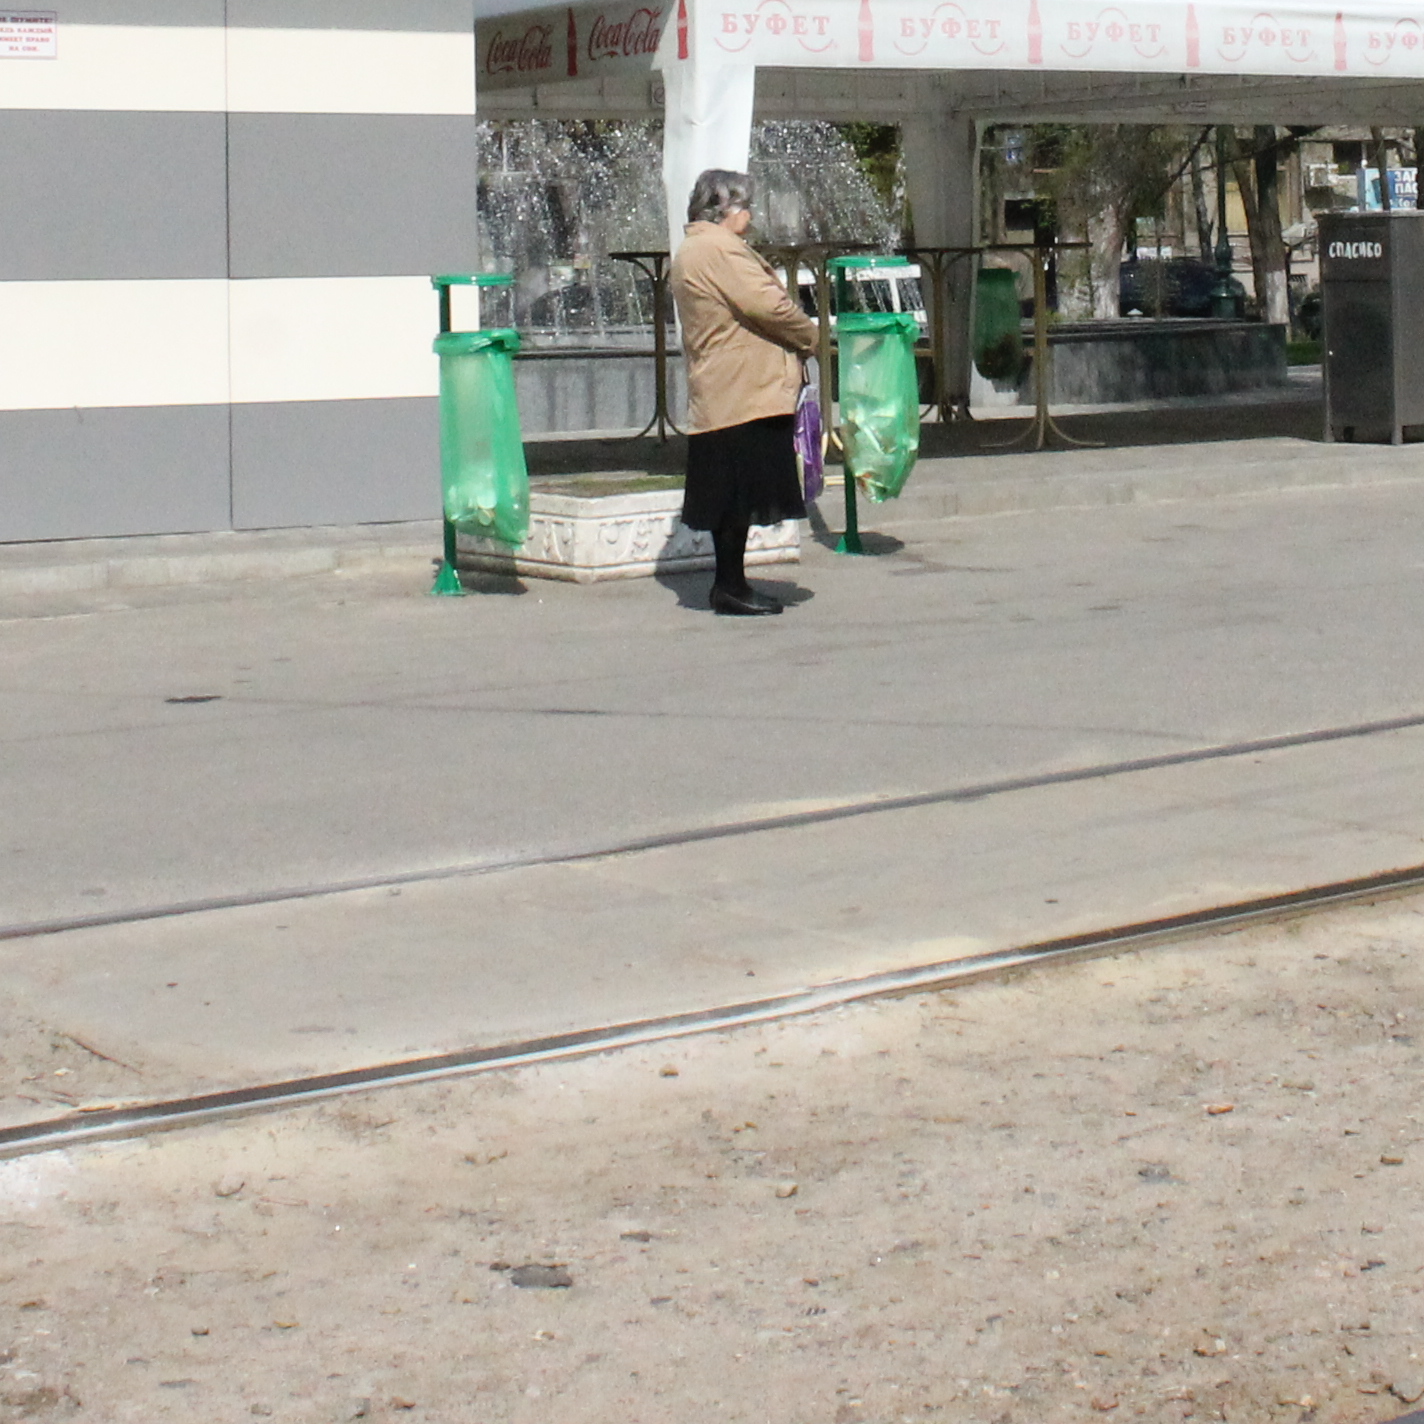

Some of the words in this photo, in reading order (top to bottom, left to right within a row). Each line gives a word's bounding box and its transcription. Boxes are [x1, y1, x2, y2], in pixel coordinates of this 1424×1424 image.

[721, 13, 830, 37] БУФЕТ
[900, 17, 1002, 40] БУФЕТ
[1067, 22, 1161, 43] БУФЕТ
[1222, 27, 1312, 48] БУФЕТ
[1329, 241, 1382, 259] СПАСИБО
